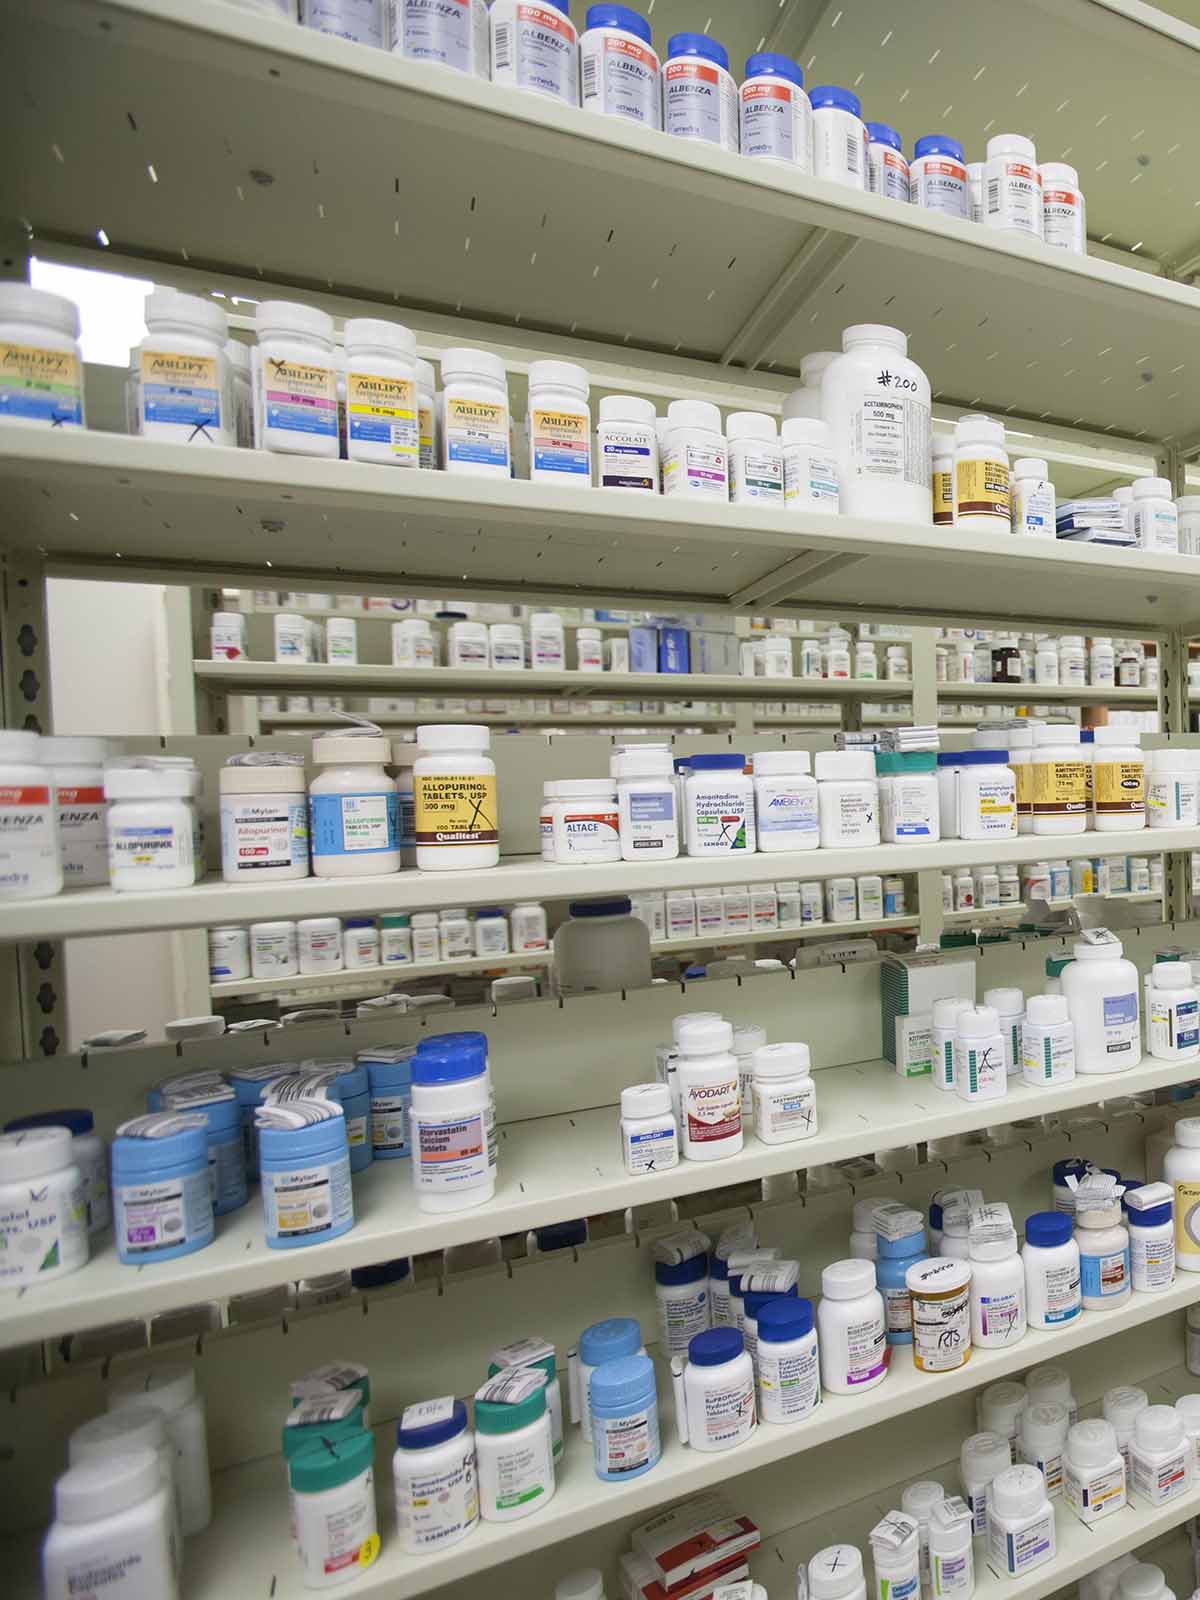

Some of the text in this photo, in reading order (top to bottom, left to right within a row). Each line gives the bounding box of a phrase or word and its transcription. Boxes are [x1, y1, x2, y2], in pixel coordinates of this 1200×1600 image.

[521, 28, 572, 56] ALBENZA
[608, 59, 655, 83] ALBENZA
[668, 85, 713, 96] ALBENZA
[745, 104, 785, 115] ALBENZA
[928, 179, 963, 192] ALBENZA
[1008, 180, 1034, 191] ALBEN
[152, 357, 205, 373] ABILIFY
[275, 367, 327, 383] ABILIFY
[877, 369, 918, 392] #200
[357, 380, 407, 393] ABILIFY
[455, 405, 497, 417] ABILIFY
[863, 400, 904, 411] ACETAMINOPHEN
[885, 412, 895, 420] mg
[541, 416, 581, 428] ABILIFY
[605, 434, 648, 443] ACCOLATE
[422, 783, 488, 792] ALLOPURINOL
[423, 792, 488, 801] TABLETS, USP
[424, 802, 456, 811] 300 mg
[695, 801, 745, 809] Hydrochloride
[58, 811, 99, 823] ENZA
[251, 807, 280, 816] Mylan
[695, 807, 745, 817] Capsules, USP
[237, 824, 288, 836] Allopurinol
[566, 823, 599, 832] ALTACE
[435, 832, 480, 842] Qualitest
[688, 1085, 731, 1100] AVODART
[418, 1125, 468, 1136] Atorvastatin
[419, 1135, 450, 1145] Calcium
[420, 1144, 447, 1152] Tablets
